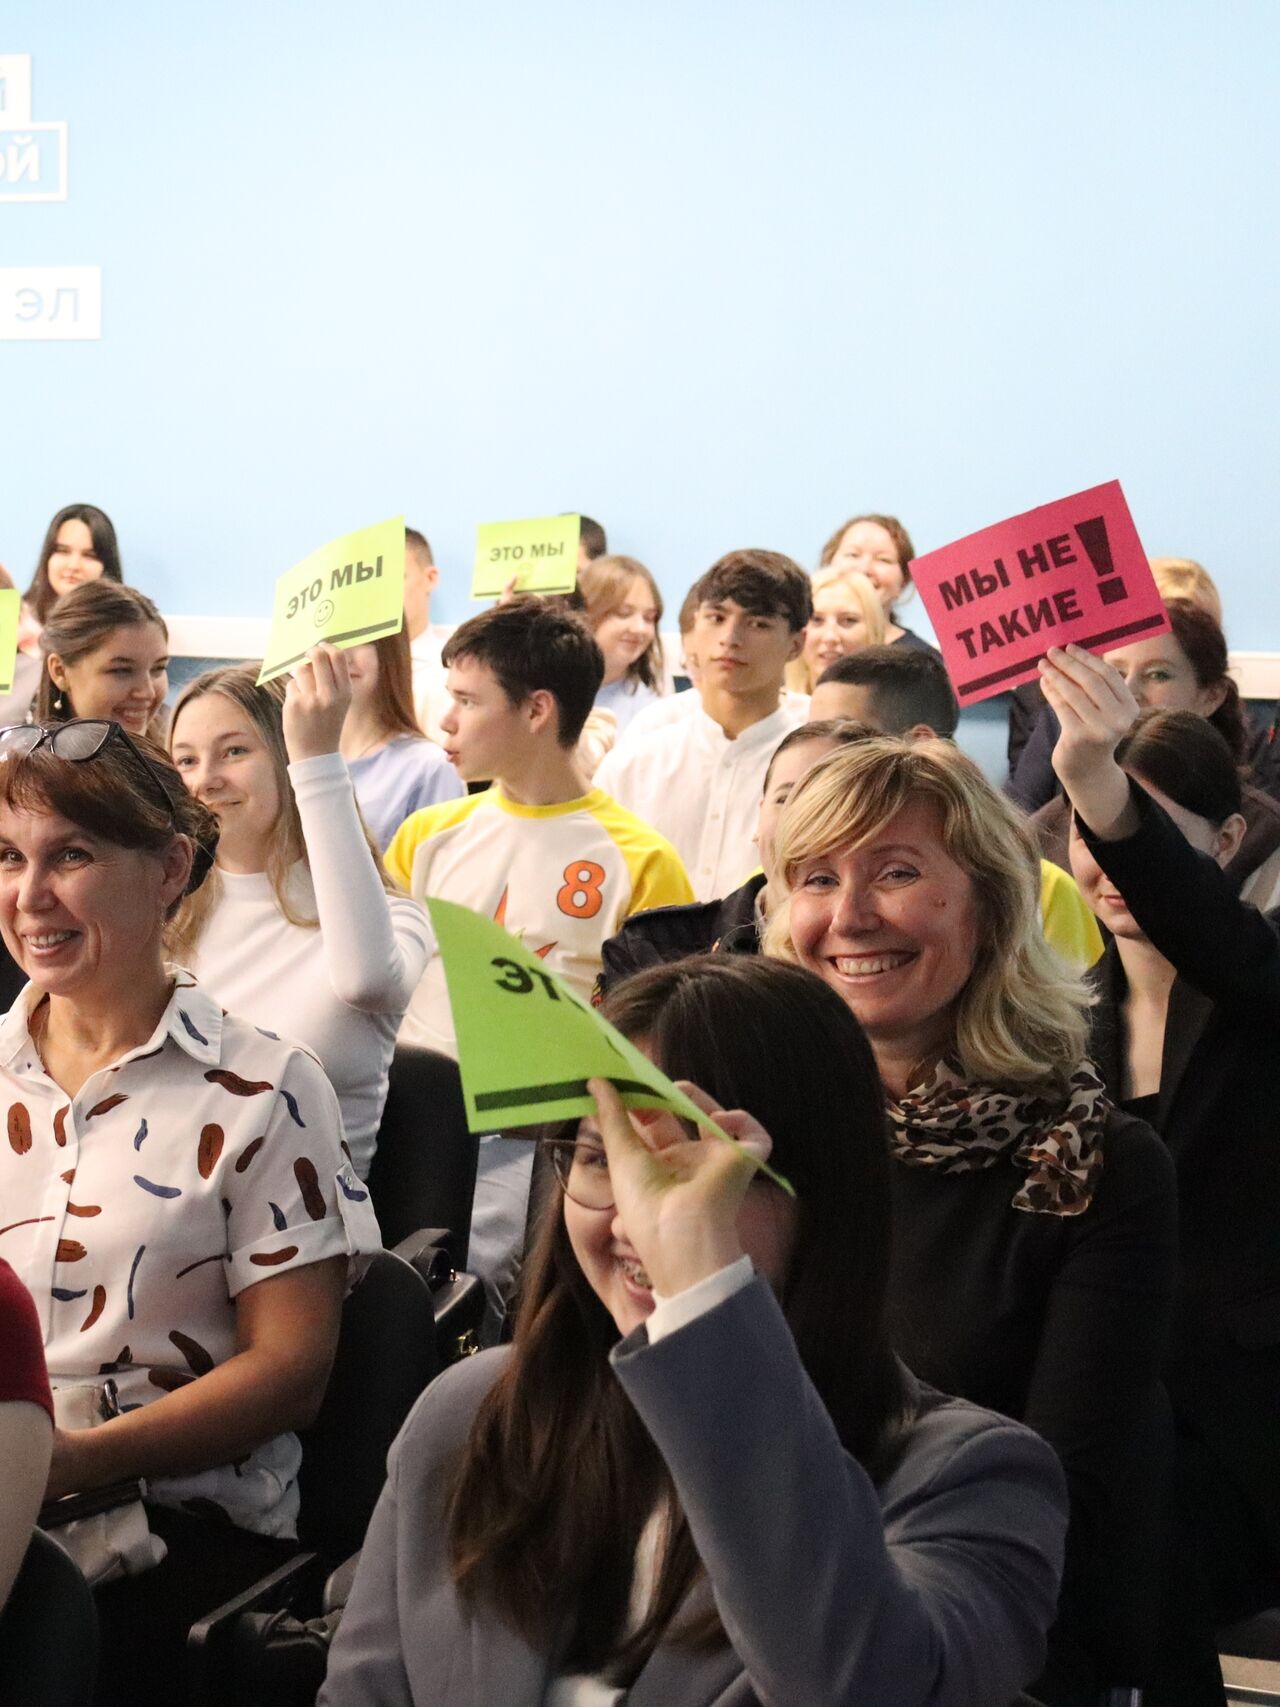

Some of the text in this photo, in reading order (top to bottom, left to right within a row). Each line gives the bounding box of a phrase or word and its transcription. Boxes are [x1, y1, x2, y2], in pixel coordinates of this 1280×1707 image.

[15, 287, 79, 323] ЭЛ
[490, 541, 565, 562] ЭТО МЫ
[938, 533, 1079, 611] МЫ НЕ
[285, 555, 383, 620] ЭТО МЫ
[955, 588, 1084, 660] ТАКИЕ
[556, 860, 606, 919] 8
